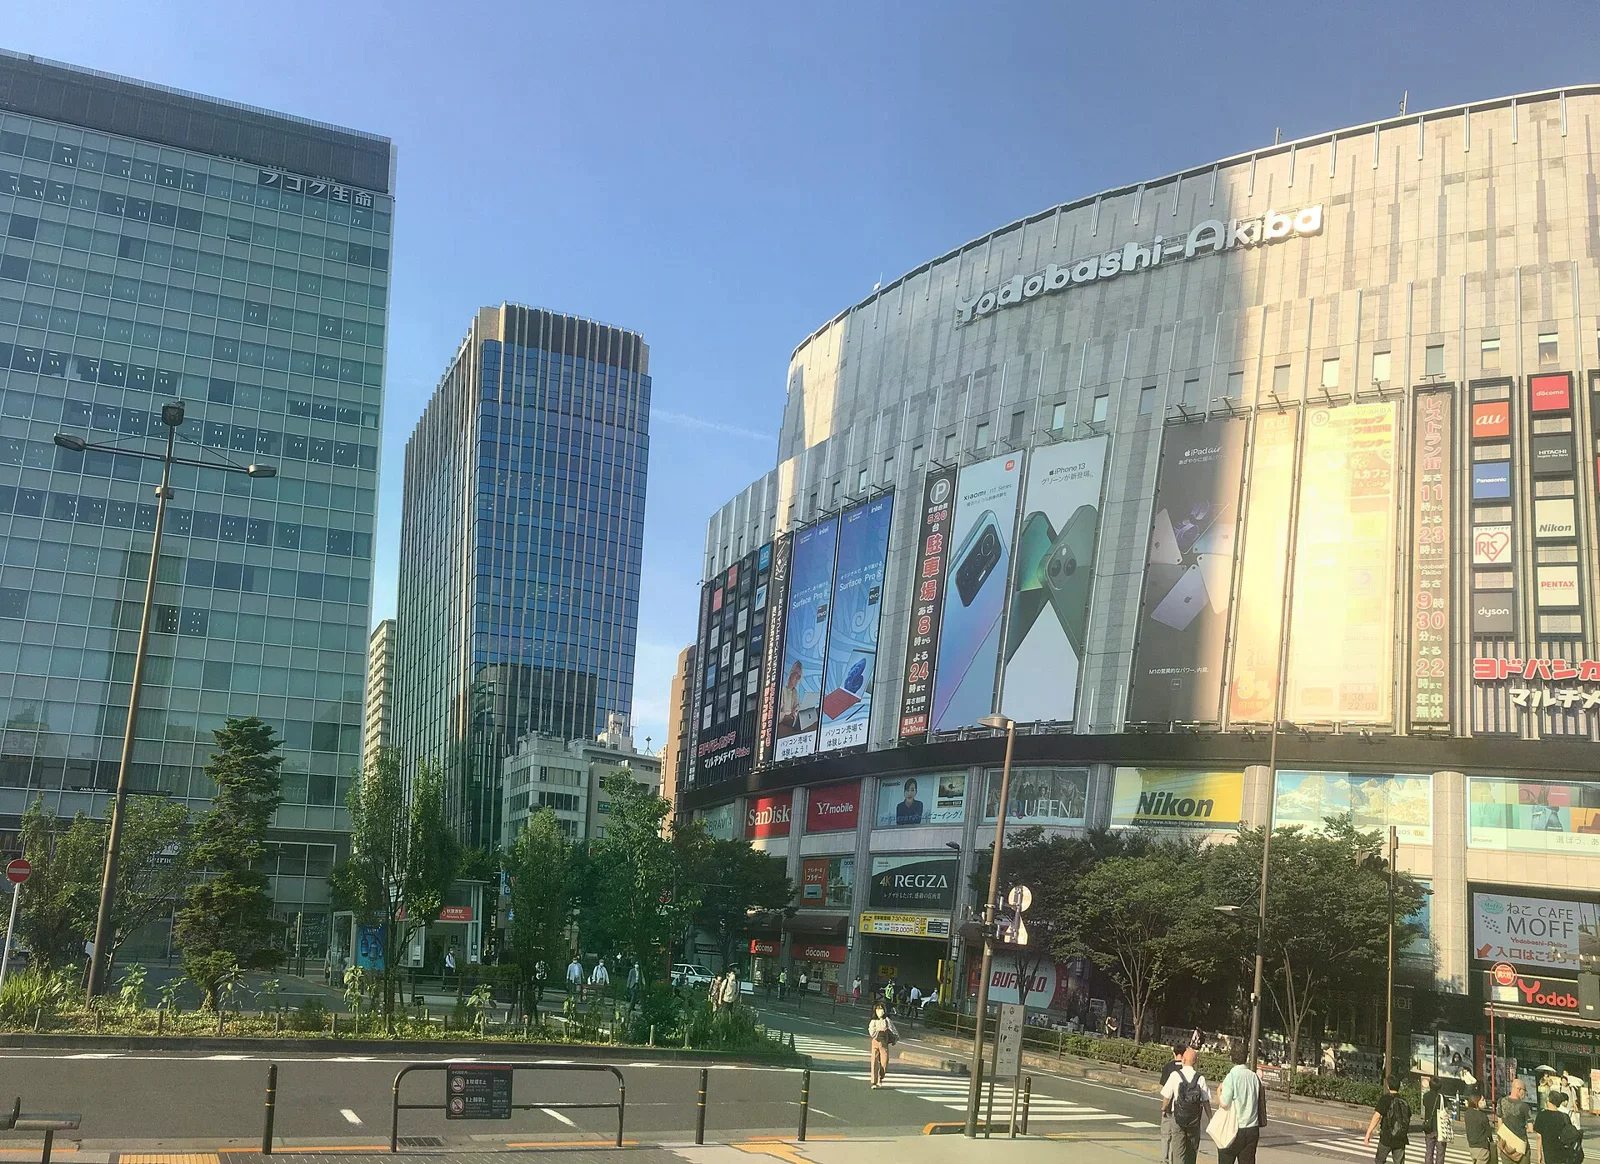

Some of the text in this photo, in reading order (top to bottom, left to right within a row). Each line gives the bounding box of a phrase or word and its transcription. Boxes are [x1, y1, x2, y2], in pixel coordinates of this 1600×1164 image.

[262, 170, 372, 207] フコク生命
[956, 203, 1323, 322] Yodobashi-Akiba
[1536, 389, 1564, 397] docomo
[1476, 414, 1505, 425] au
[1423, 398, 1443, 470] レストラン街
[1055, 462, 1085, 475] iPhone 13
[1421, 473, 1443, 483] あさ
[934, 482, 946, 502] P
[1420, 484, 1443, 501] 11
[926, 510, 948, 524] 520
[1421, 515, 1442, 525] よる
[1419, 526, 1445, 544] 23
[1539, 524, 1572, 532] Nikon
[1475, 540, 1498, 555] IRIS
[919, 533, 943, 602] 駐車場
[864, 572, 876, 583] Pro
[1420, 579, 1442, 589] あさ
[1478, 606, 1509, 617] dyson
[917, 615, 931, 635] 8
[1416, 611, 1445, 630] 30
[912, 651, 929, 662] よる
[1418, 646, 1442, 656] よる
[908, 660, 929, 683] 24
[1416, 658, 1445, 677] 22
[1416, 693, 1443, 706] 年中
[1416, 706, 1443, 719] 無休
[825, 722, 864, 737] パソコン売場で
[816, 802, 854, 815] Y!mobile
[1135, 791, 1214, 818] Nikon
[748, 805, 791, 827] SanDisk
[879, 874, 948, 888] 4K REGZA
[1506, 902, 1573, 921] ねこ CAFE
[1506, 916, 1574, 939] MOFF
[755, 942, 773, 953] docomo
[805, 946, 830, 958] docomo
[991, 971, 1047, 993] BUFLO
[1541, 1026, 1593, 1040] ヨドバシカメラ
